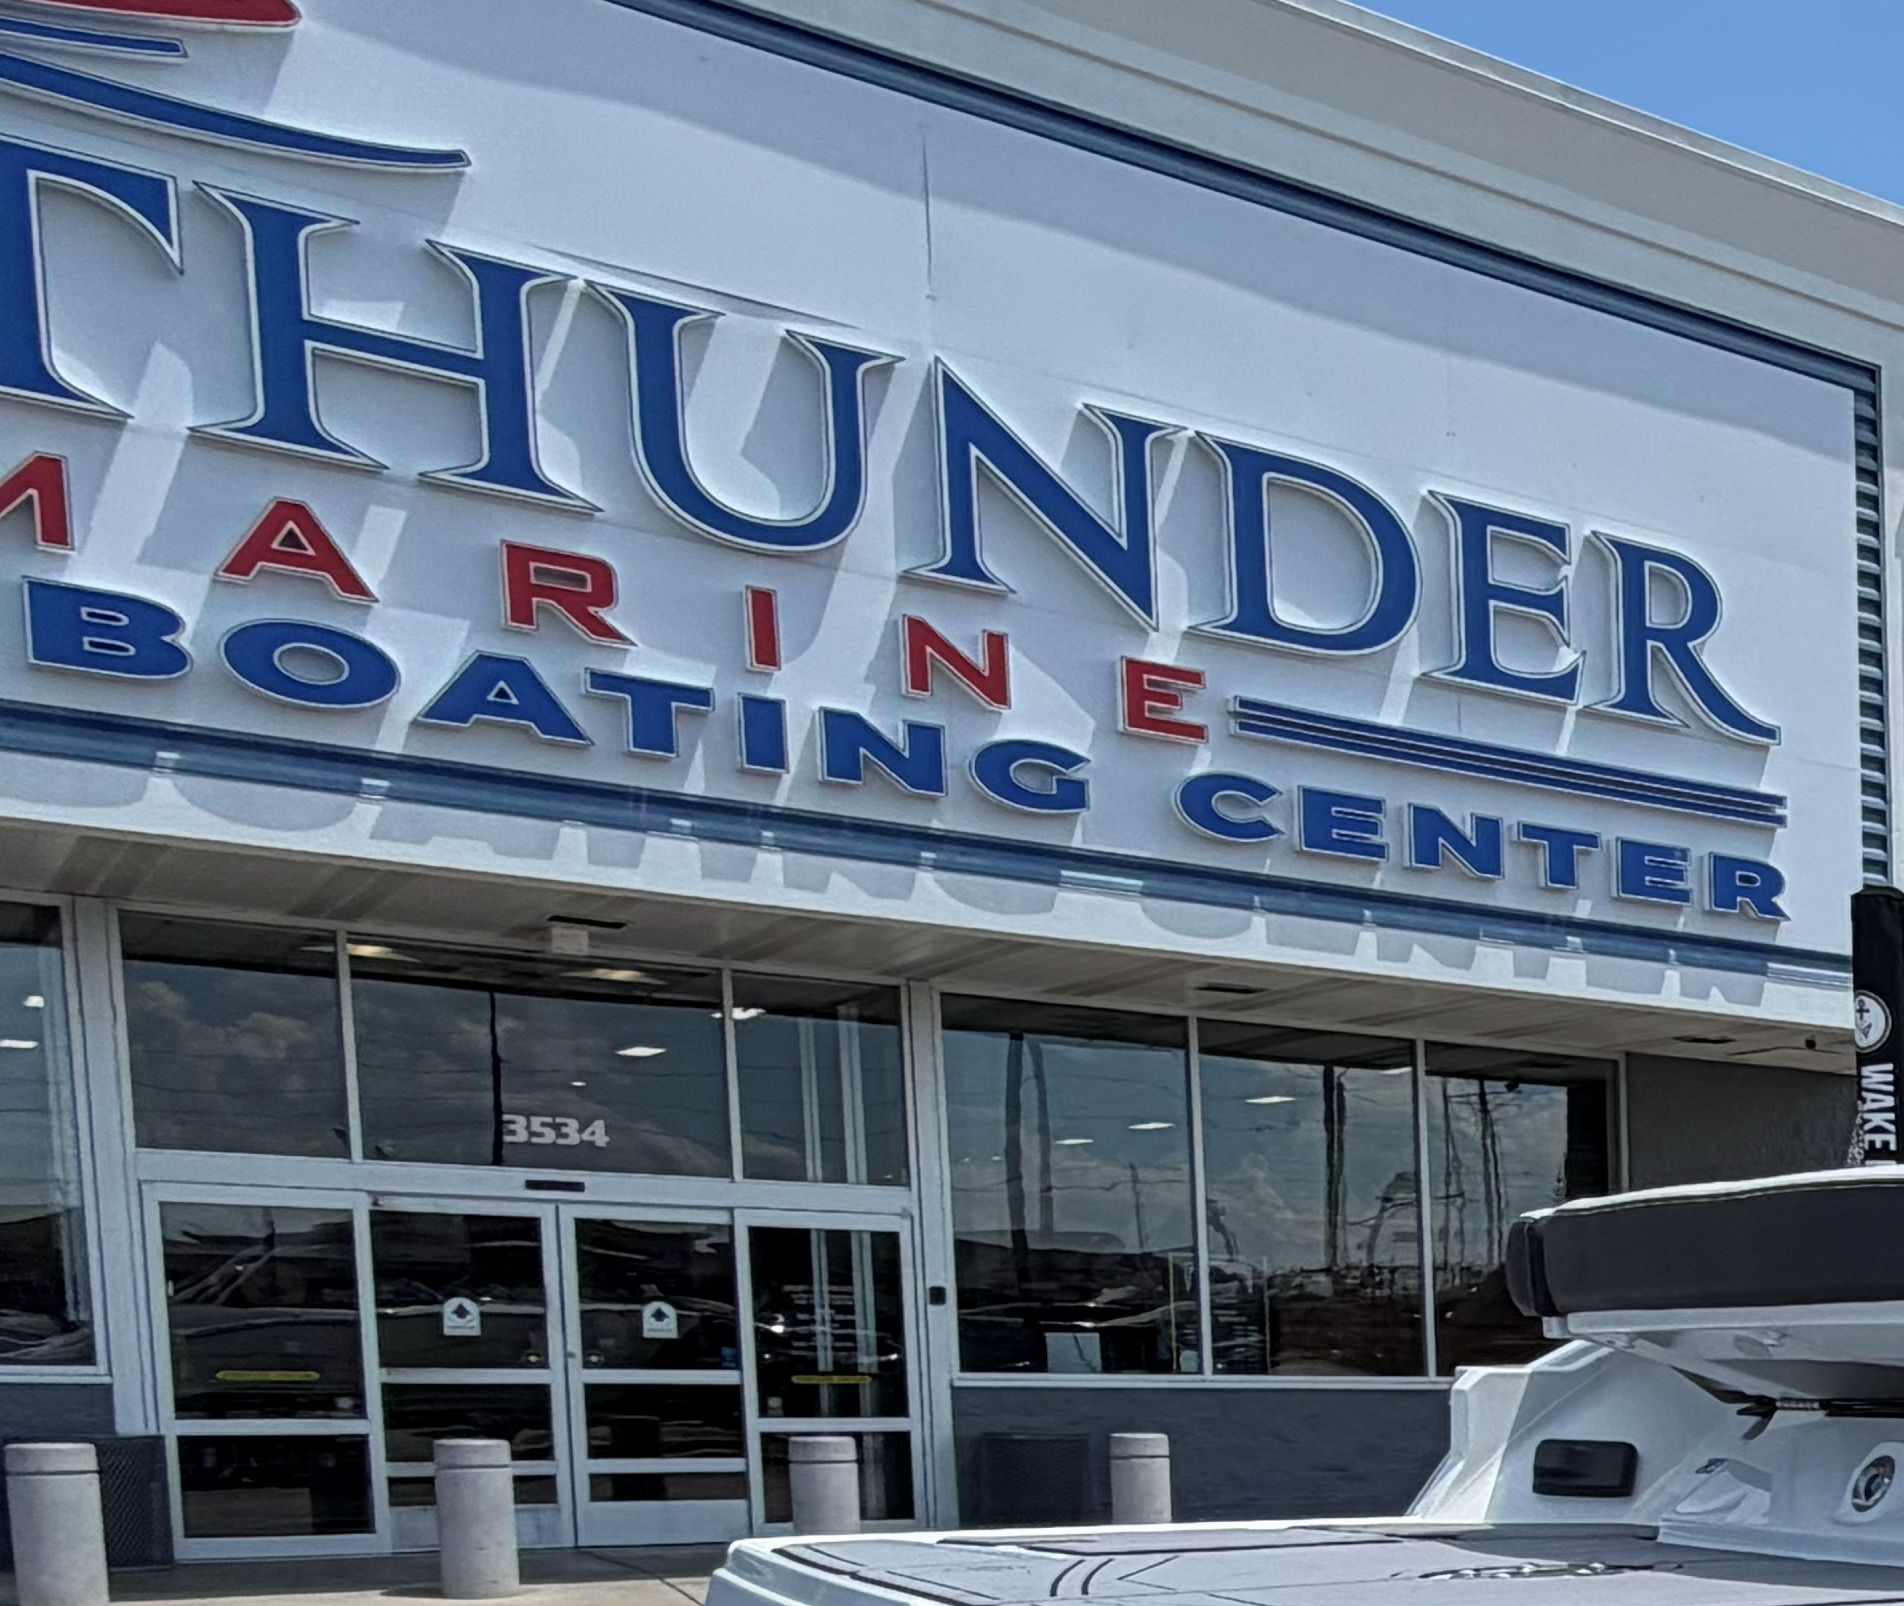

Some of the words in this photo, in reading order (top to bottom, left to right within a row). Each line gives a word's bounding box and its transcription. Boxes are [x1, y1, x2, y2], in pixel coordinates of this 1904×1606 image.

[21, 576, 1091, 814] BOATING
[1174, 771, 1790, 921] CENTER
[501, 1113, 611, 1148] 3534
[1860, 1063, 1897, 1151] WAKE
